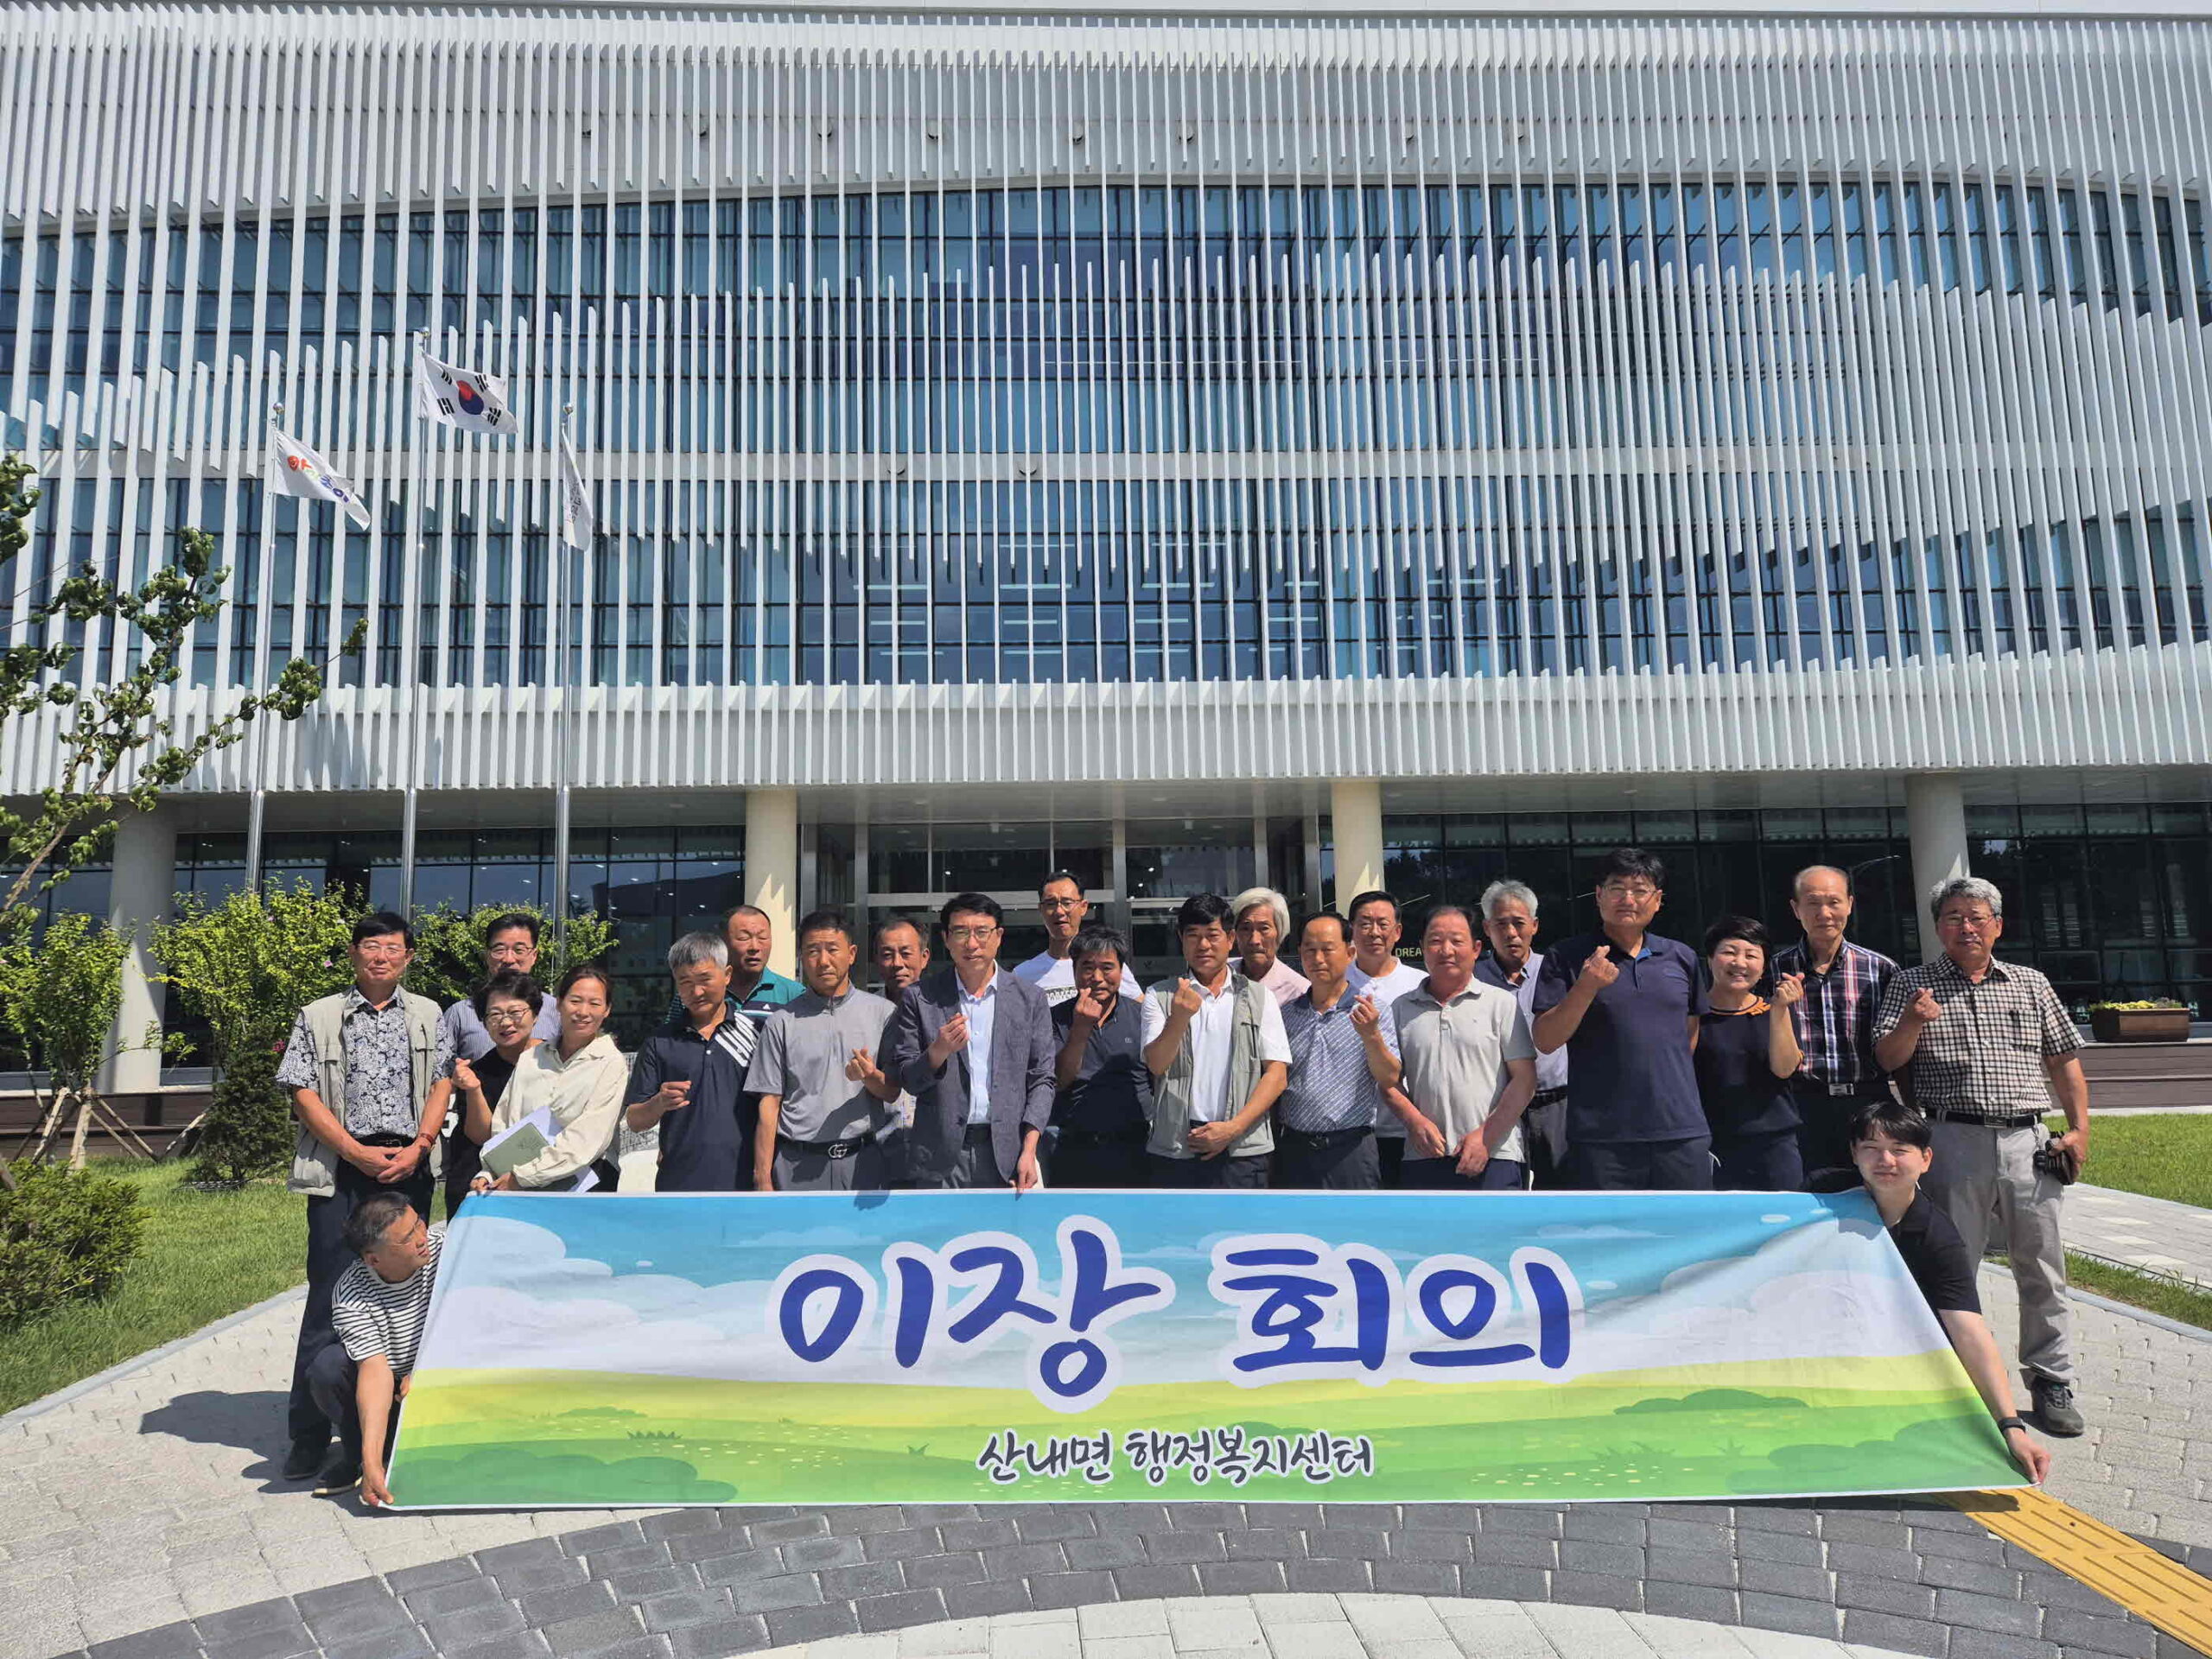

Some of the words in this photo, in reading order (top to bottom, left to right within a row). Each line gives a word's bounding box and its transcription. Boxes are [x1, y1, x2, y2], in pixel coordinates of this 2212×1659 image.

[781, 1230, 1159, 1396] 이장
[1224, 1249, 1569, 1371] 회의
[980, 1433, 1109, 1480] 산내면
[1127, 1430, 1370, 1483] 행정복지센터
